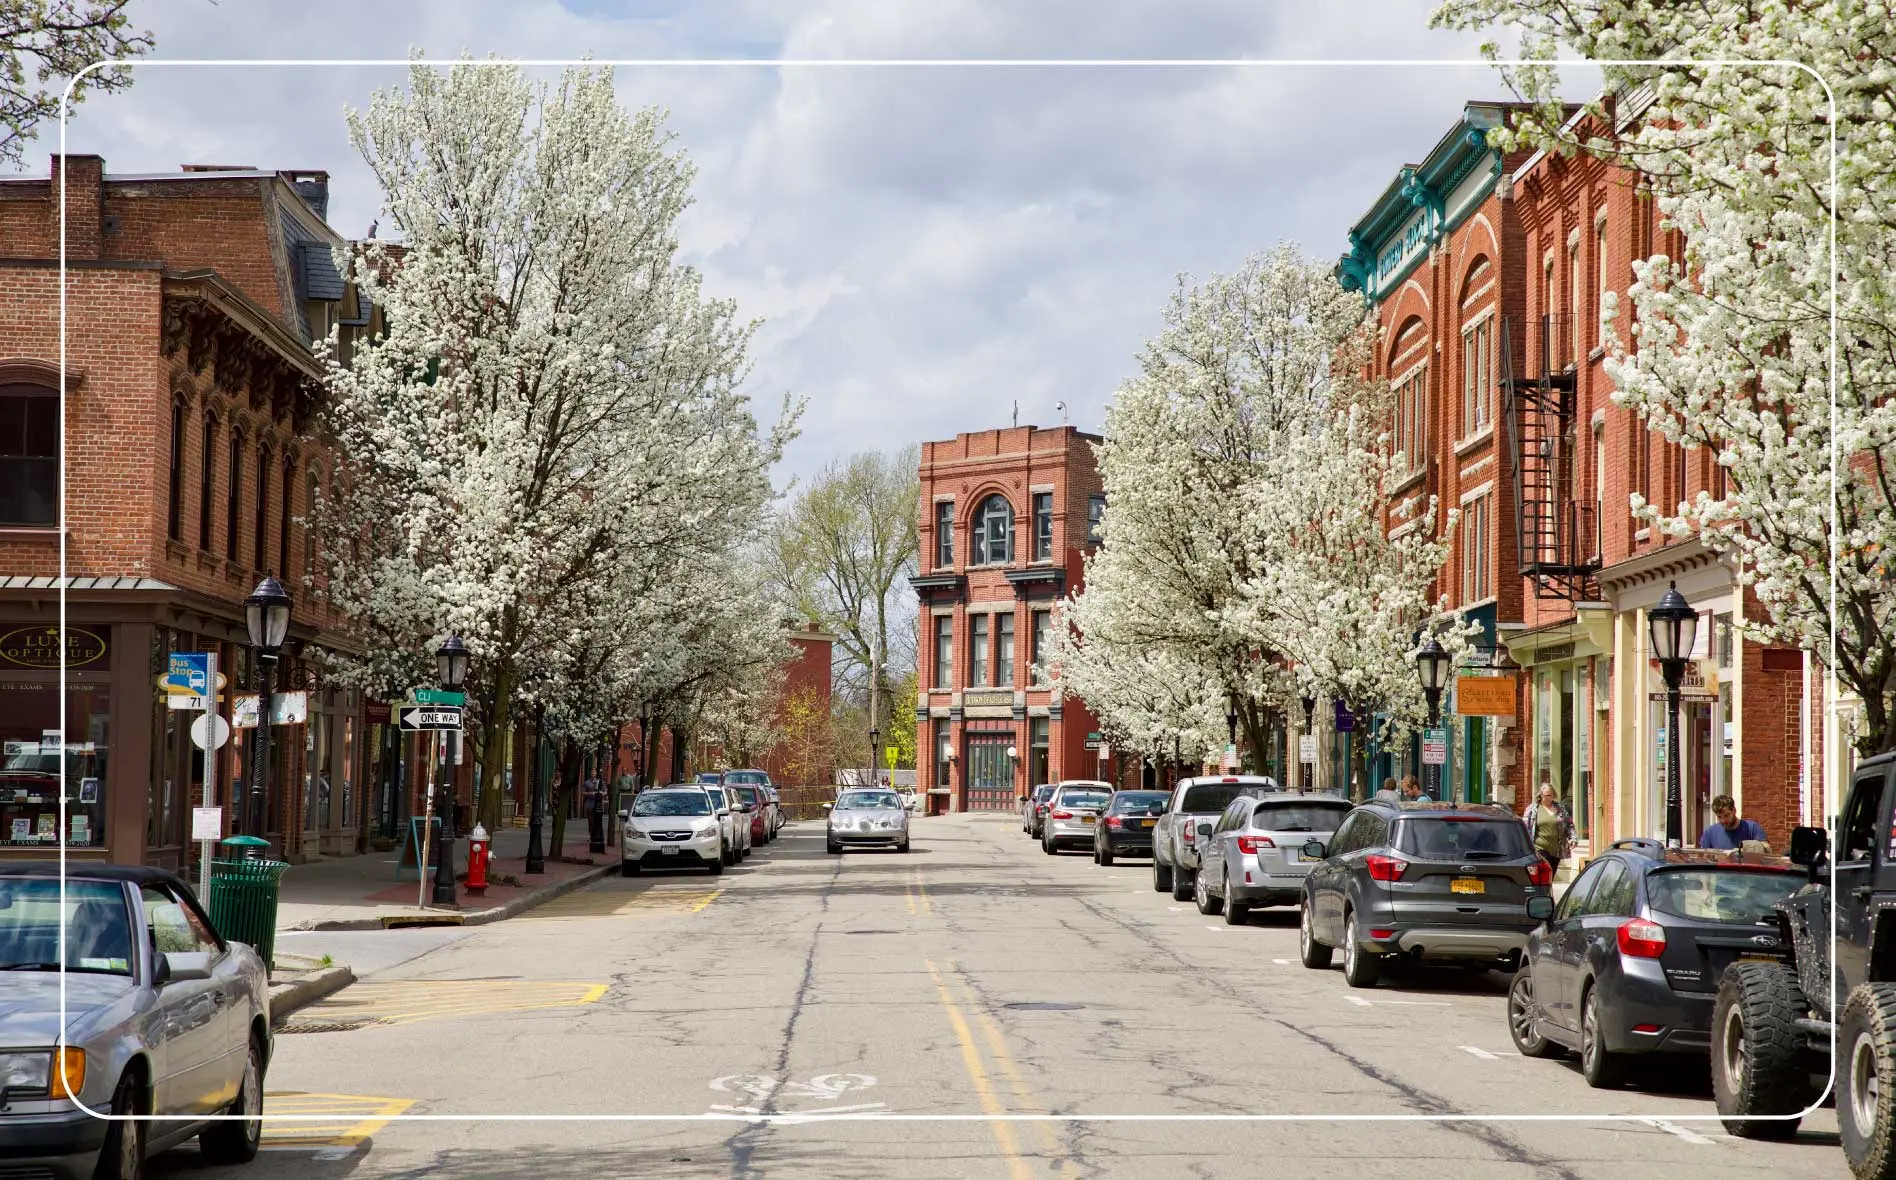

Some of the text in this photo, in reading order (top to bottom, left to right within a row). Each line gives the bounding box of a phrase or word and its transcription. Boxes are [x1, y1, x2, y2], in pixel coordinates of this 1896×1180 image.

[25, 635, 80, 647] LUXE
[170, 658, 188, 667] Bus
[170, 667, 192, 677] Stop
[190, 697, 201, 707] 71
[420, 713, 458, 723] ONE WAY
